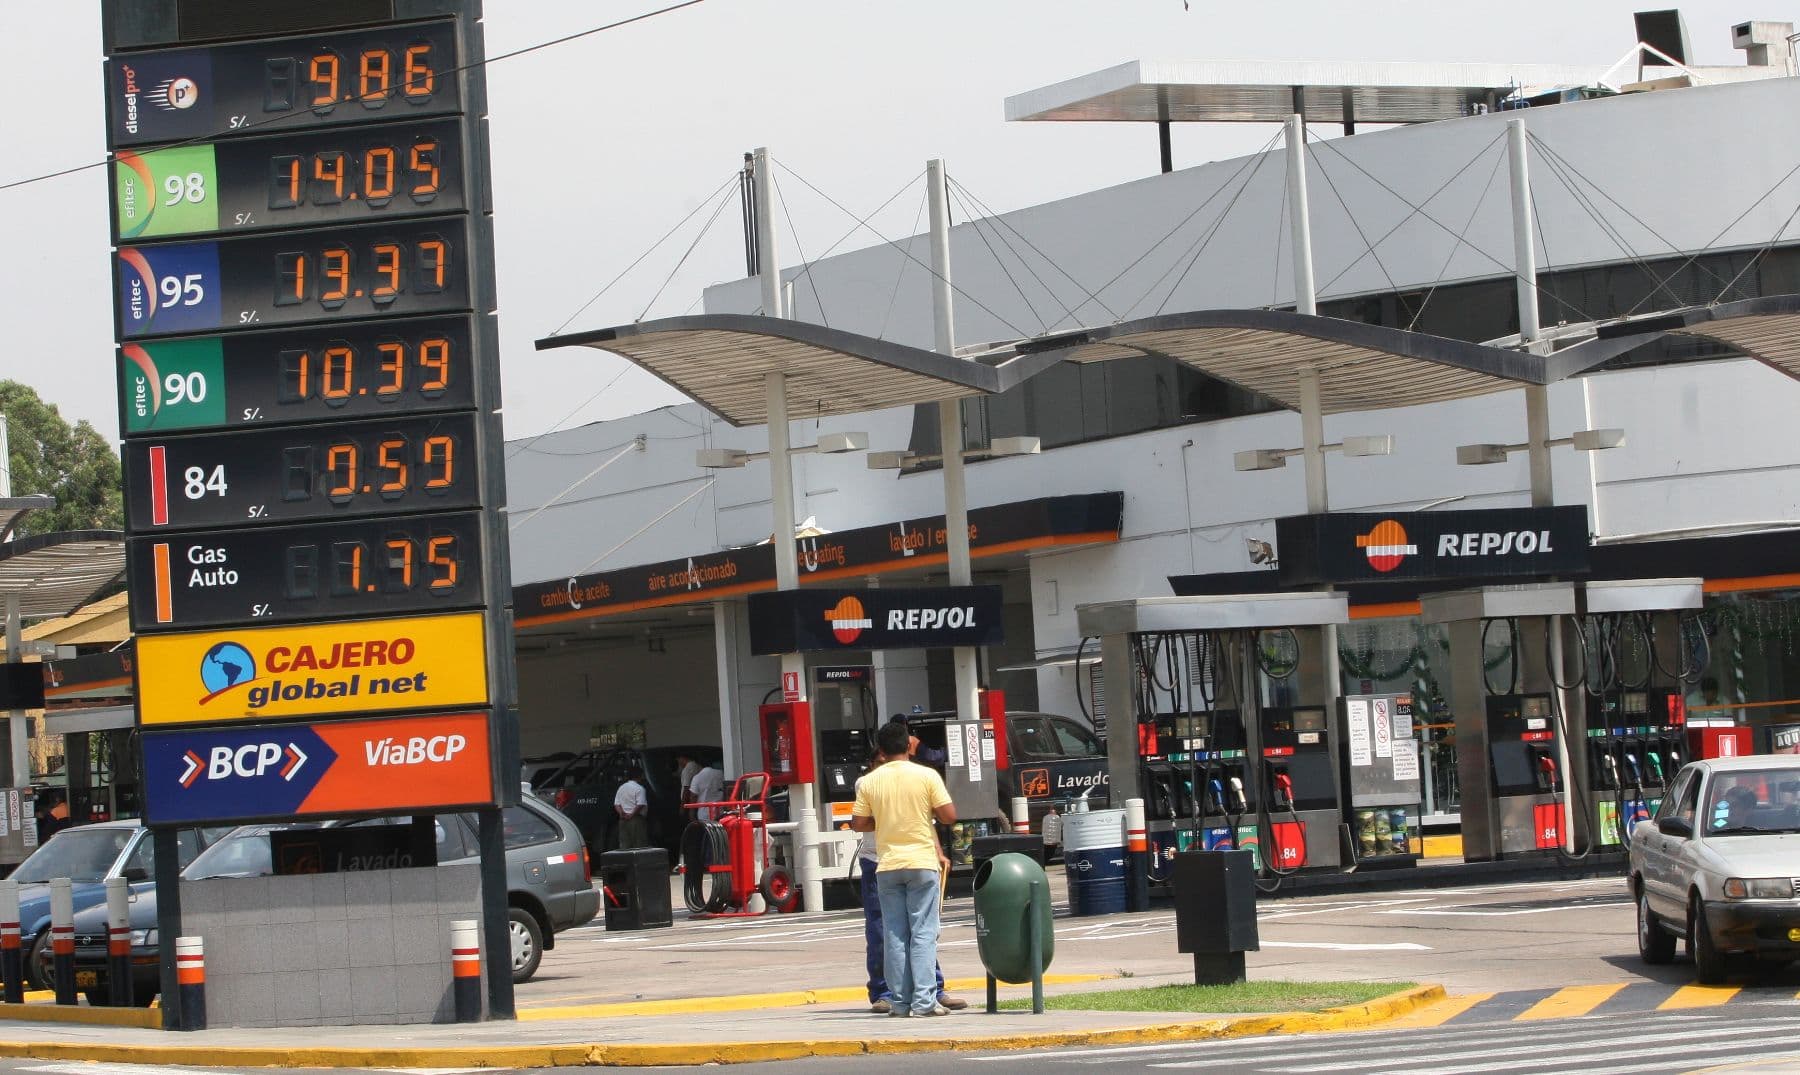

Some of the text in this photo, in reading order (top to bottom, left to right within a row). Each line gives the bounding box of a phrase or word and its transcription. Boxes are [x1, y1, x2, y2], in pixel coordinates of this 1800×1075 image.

[309, 44, 434, 106] 9.86
[164, 172, 206, 207] 98
[289, 142, 440, 202] 14.05
[124, 177, 136, 219] efitec
[295, 240, 445, 300] 13.37
[131, 279, 143, 320] efitec
[160, 273, 204, 308] 95
[299, 338, 449, 399] 10.39
[135, 376, 147, 417] efitec
[164, 371, 207, 406] 90
[184, 464, 228, 500] 84
[187, 545, 227, 565] Gas
[1437, 530, 1553, 557] REPSOL
[188, 567, 239, 587] Auto
[352, 535, 457, 593] 1.75
[648, 573, 666, 591] aire
[586, 583, 611, 602] aceite
[887, 606, 976, 630] REPSOL
[264, 637, 416, 674] CAJERO
[247, 671, 428, 709] global net
[208, 742, 283, 780] BCP
[364, 734, 466, 767] VíaBCP
[1283, 848, 1297, 859] 84
